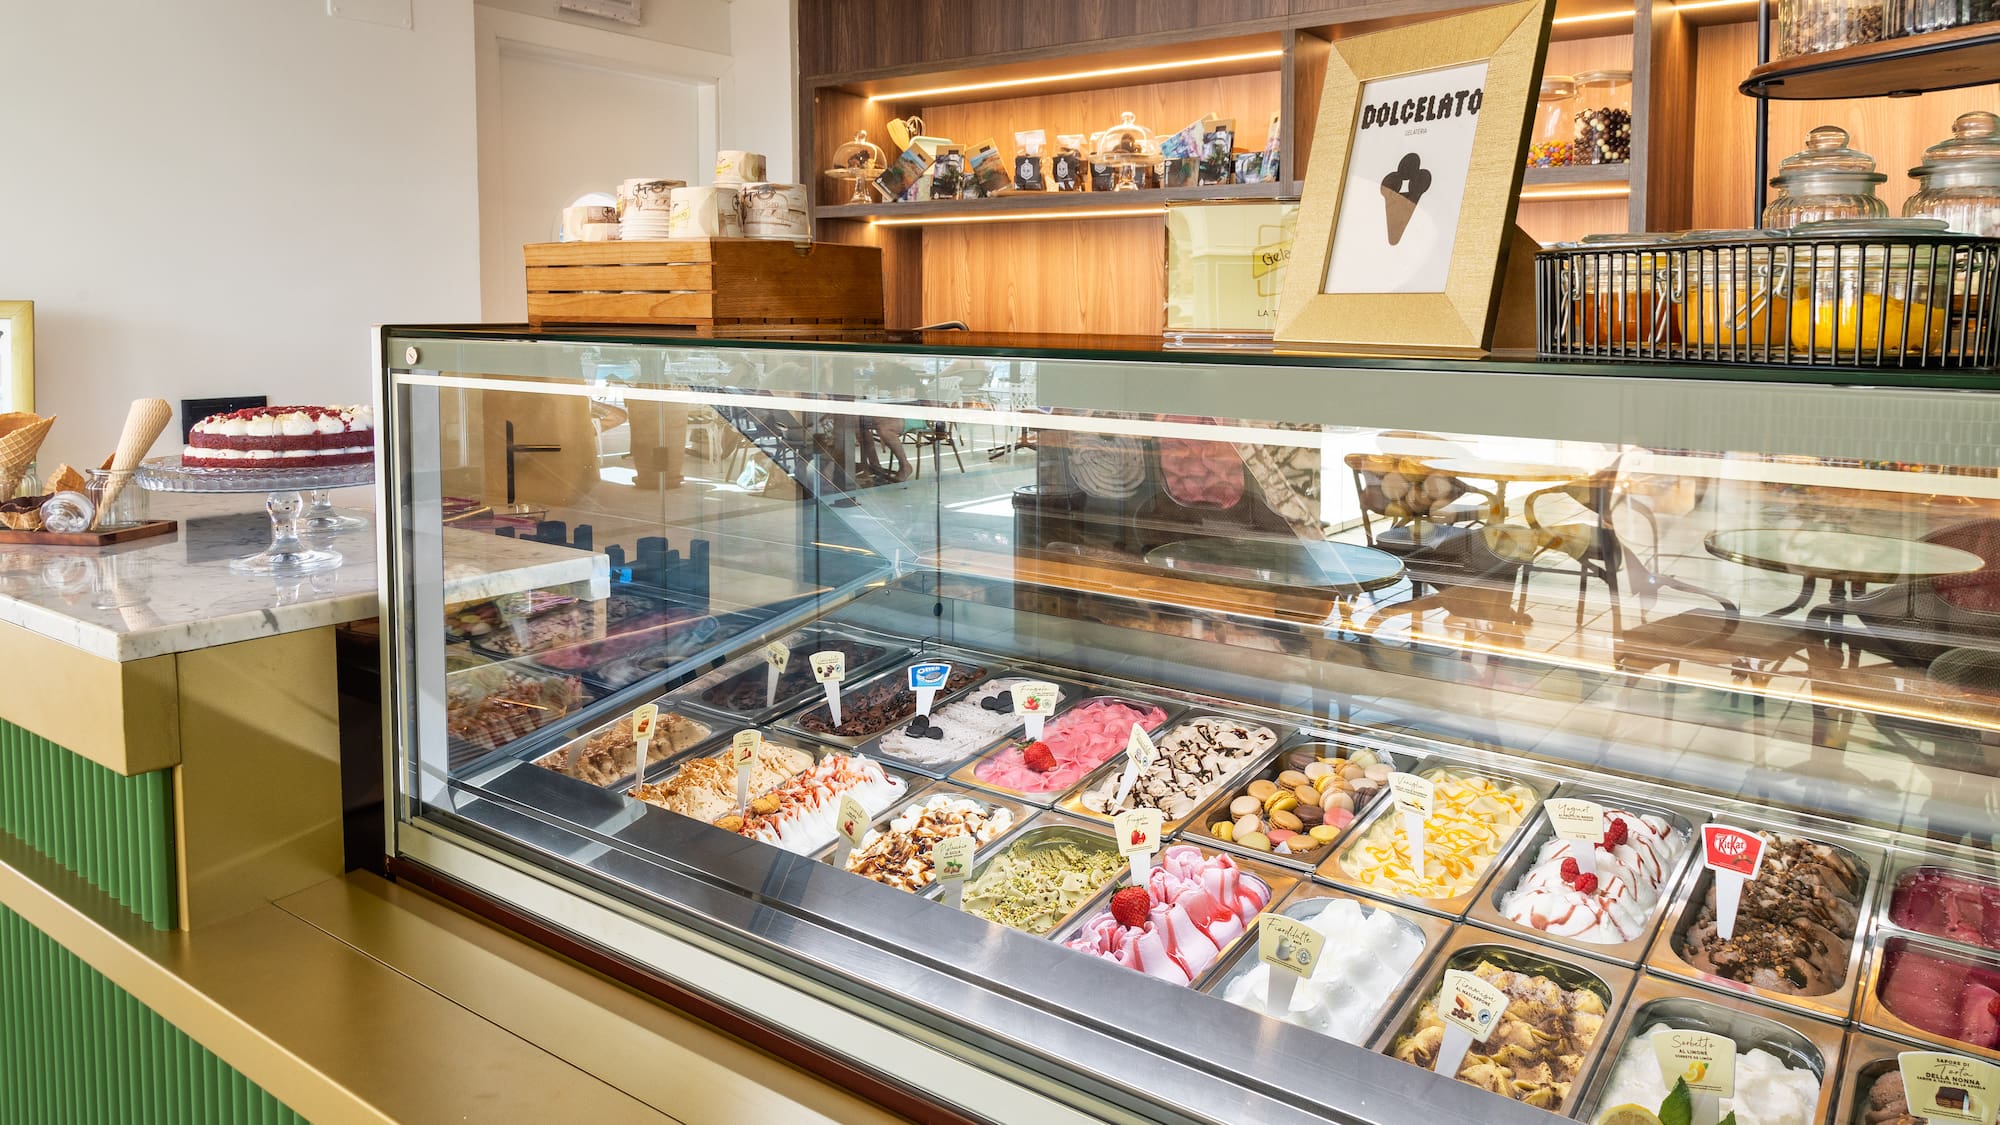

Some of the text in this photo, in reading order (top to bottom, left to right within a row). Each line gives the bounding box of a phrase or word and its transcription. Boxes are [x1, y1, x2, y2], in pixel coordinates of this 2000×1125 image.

[1361, 88, 1484, 130] DOLCELATO
[1557, 803, 1591, 815] Yogurt
[1718, 834, 1745, 855] KitKat
[1462, 989, 1491, 1007] MASCARPONE
[1672, 1034, 1716, 1051] Sorbetto
[1936, 1058, 1961, 1066] SAPORE
[1925, 1072, 1980, 1086] DELLA NONNA
